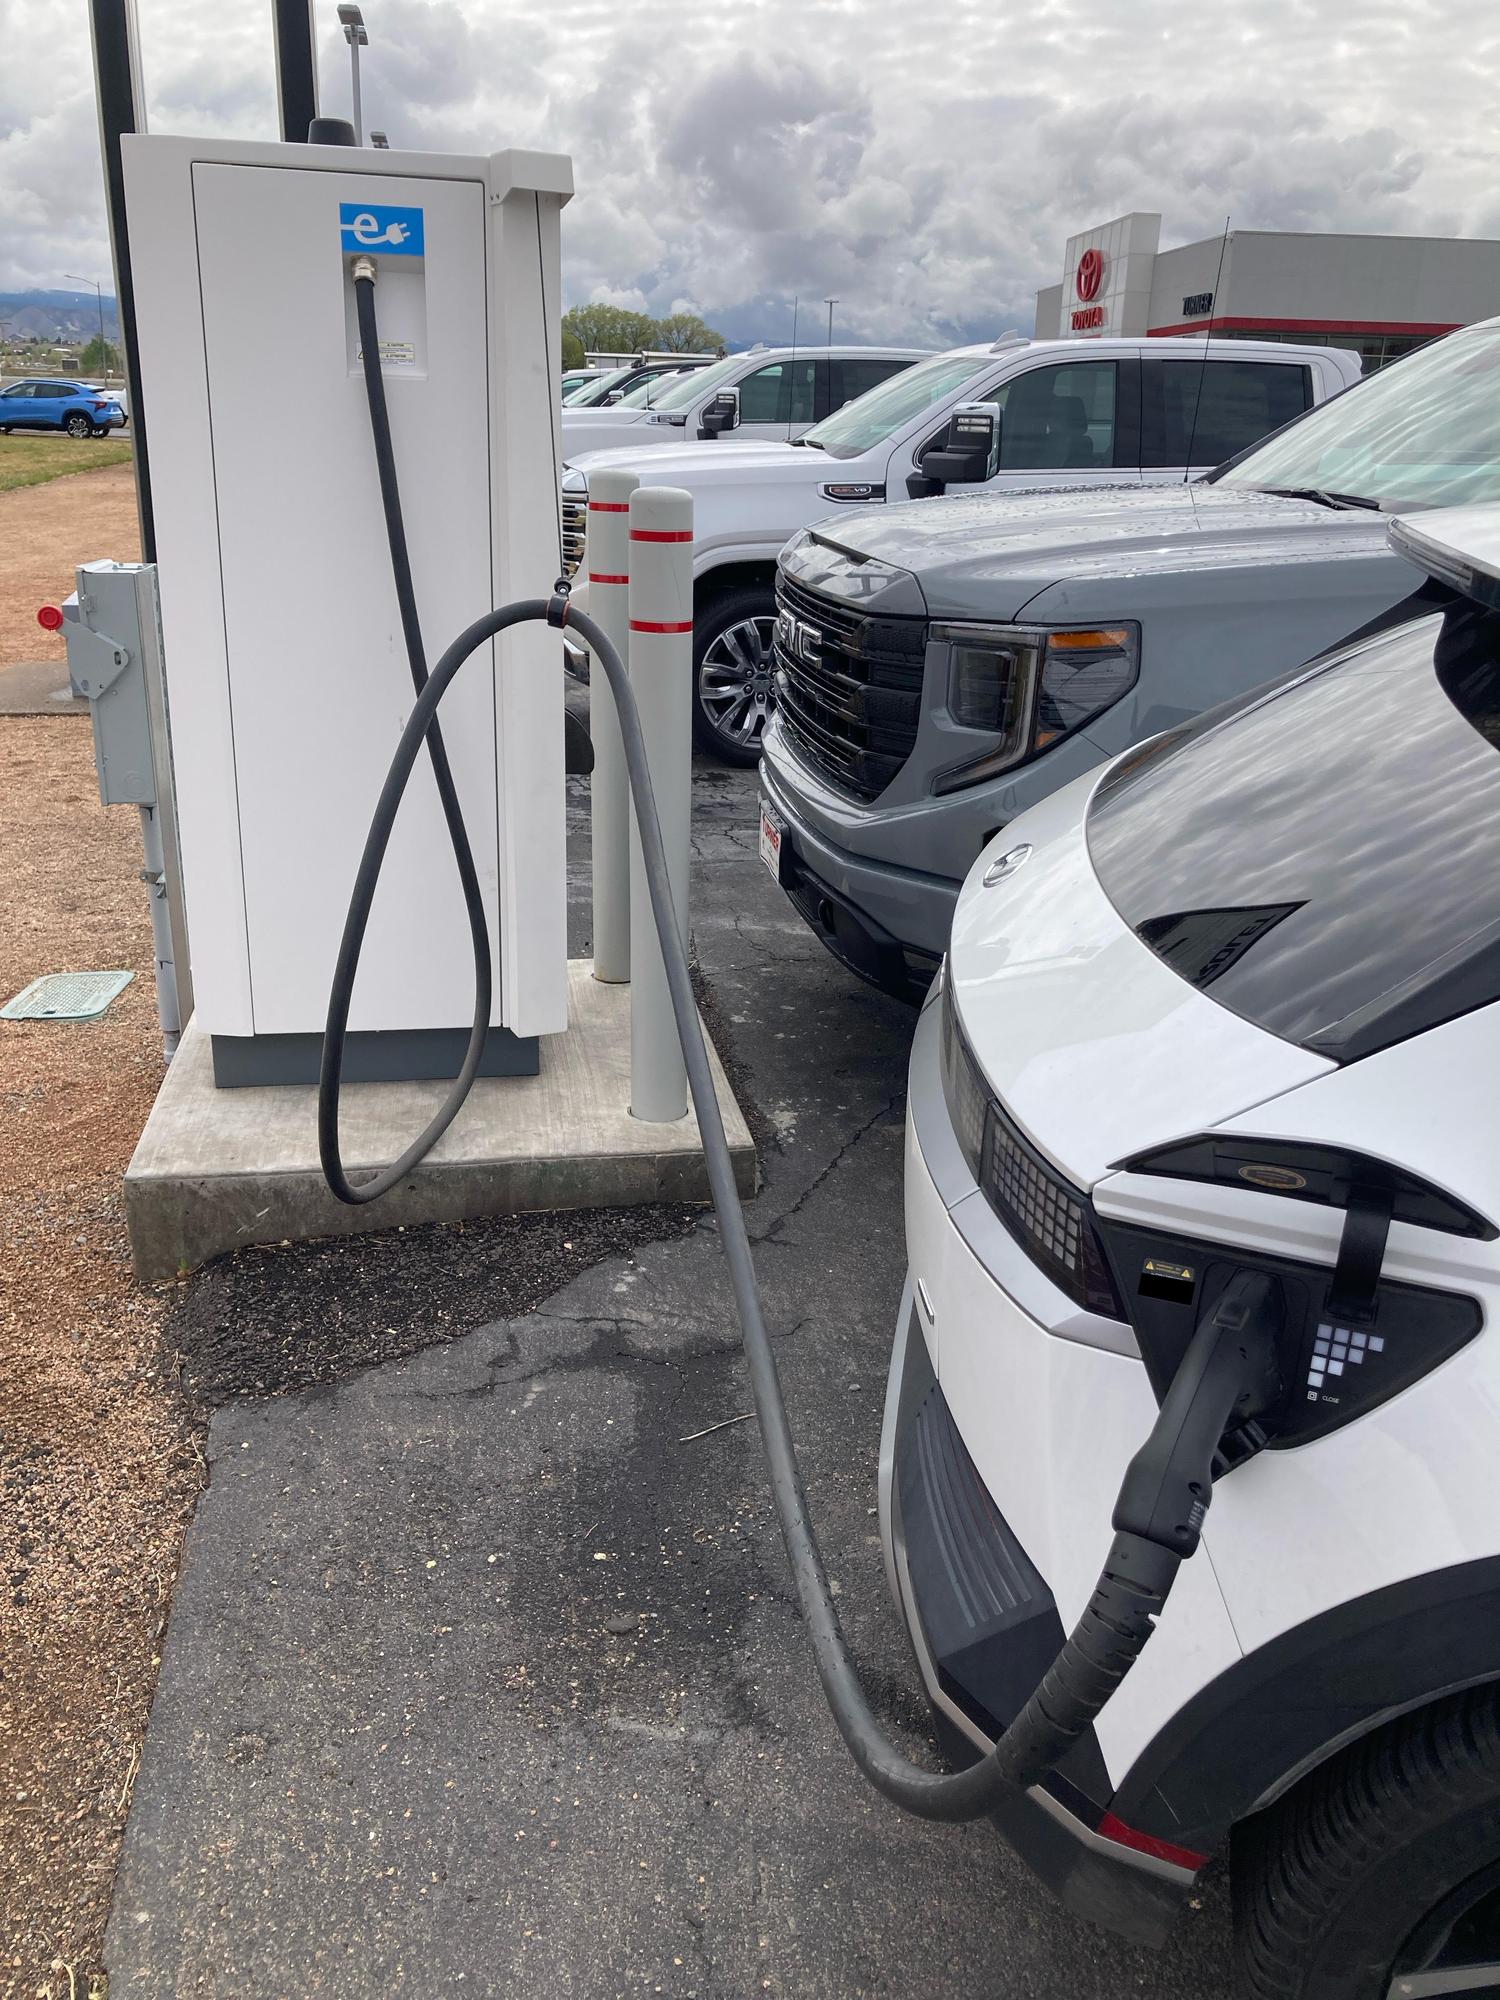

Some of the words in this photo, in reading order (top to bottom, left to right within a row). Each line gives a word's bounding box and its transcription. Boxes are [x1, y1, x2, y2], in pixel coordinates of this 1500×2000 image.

[1183, 293, 1213, 315] TURNER
[1071, 306, 1103, 330] TOYOTA
[1322, 1395, 1340, 1404] CLOSE
